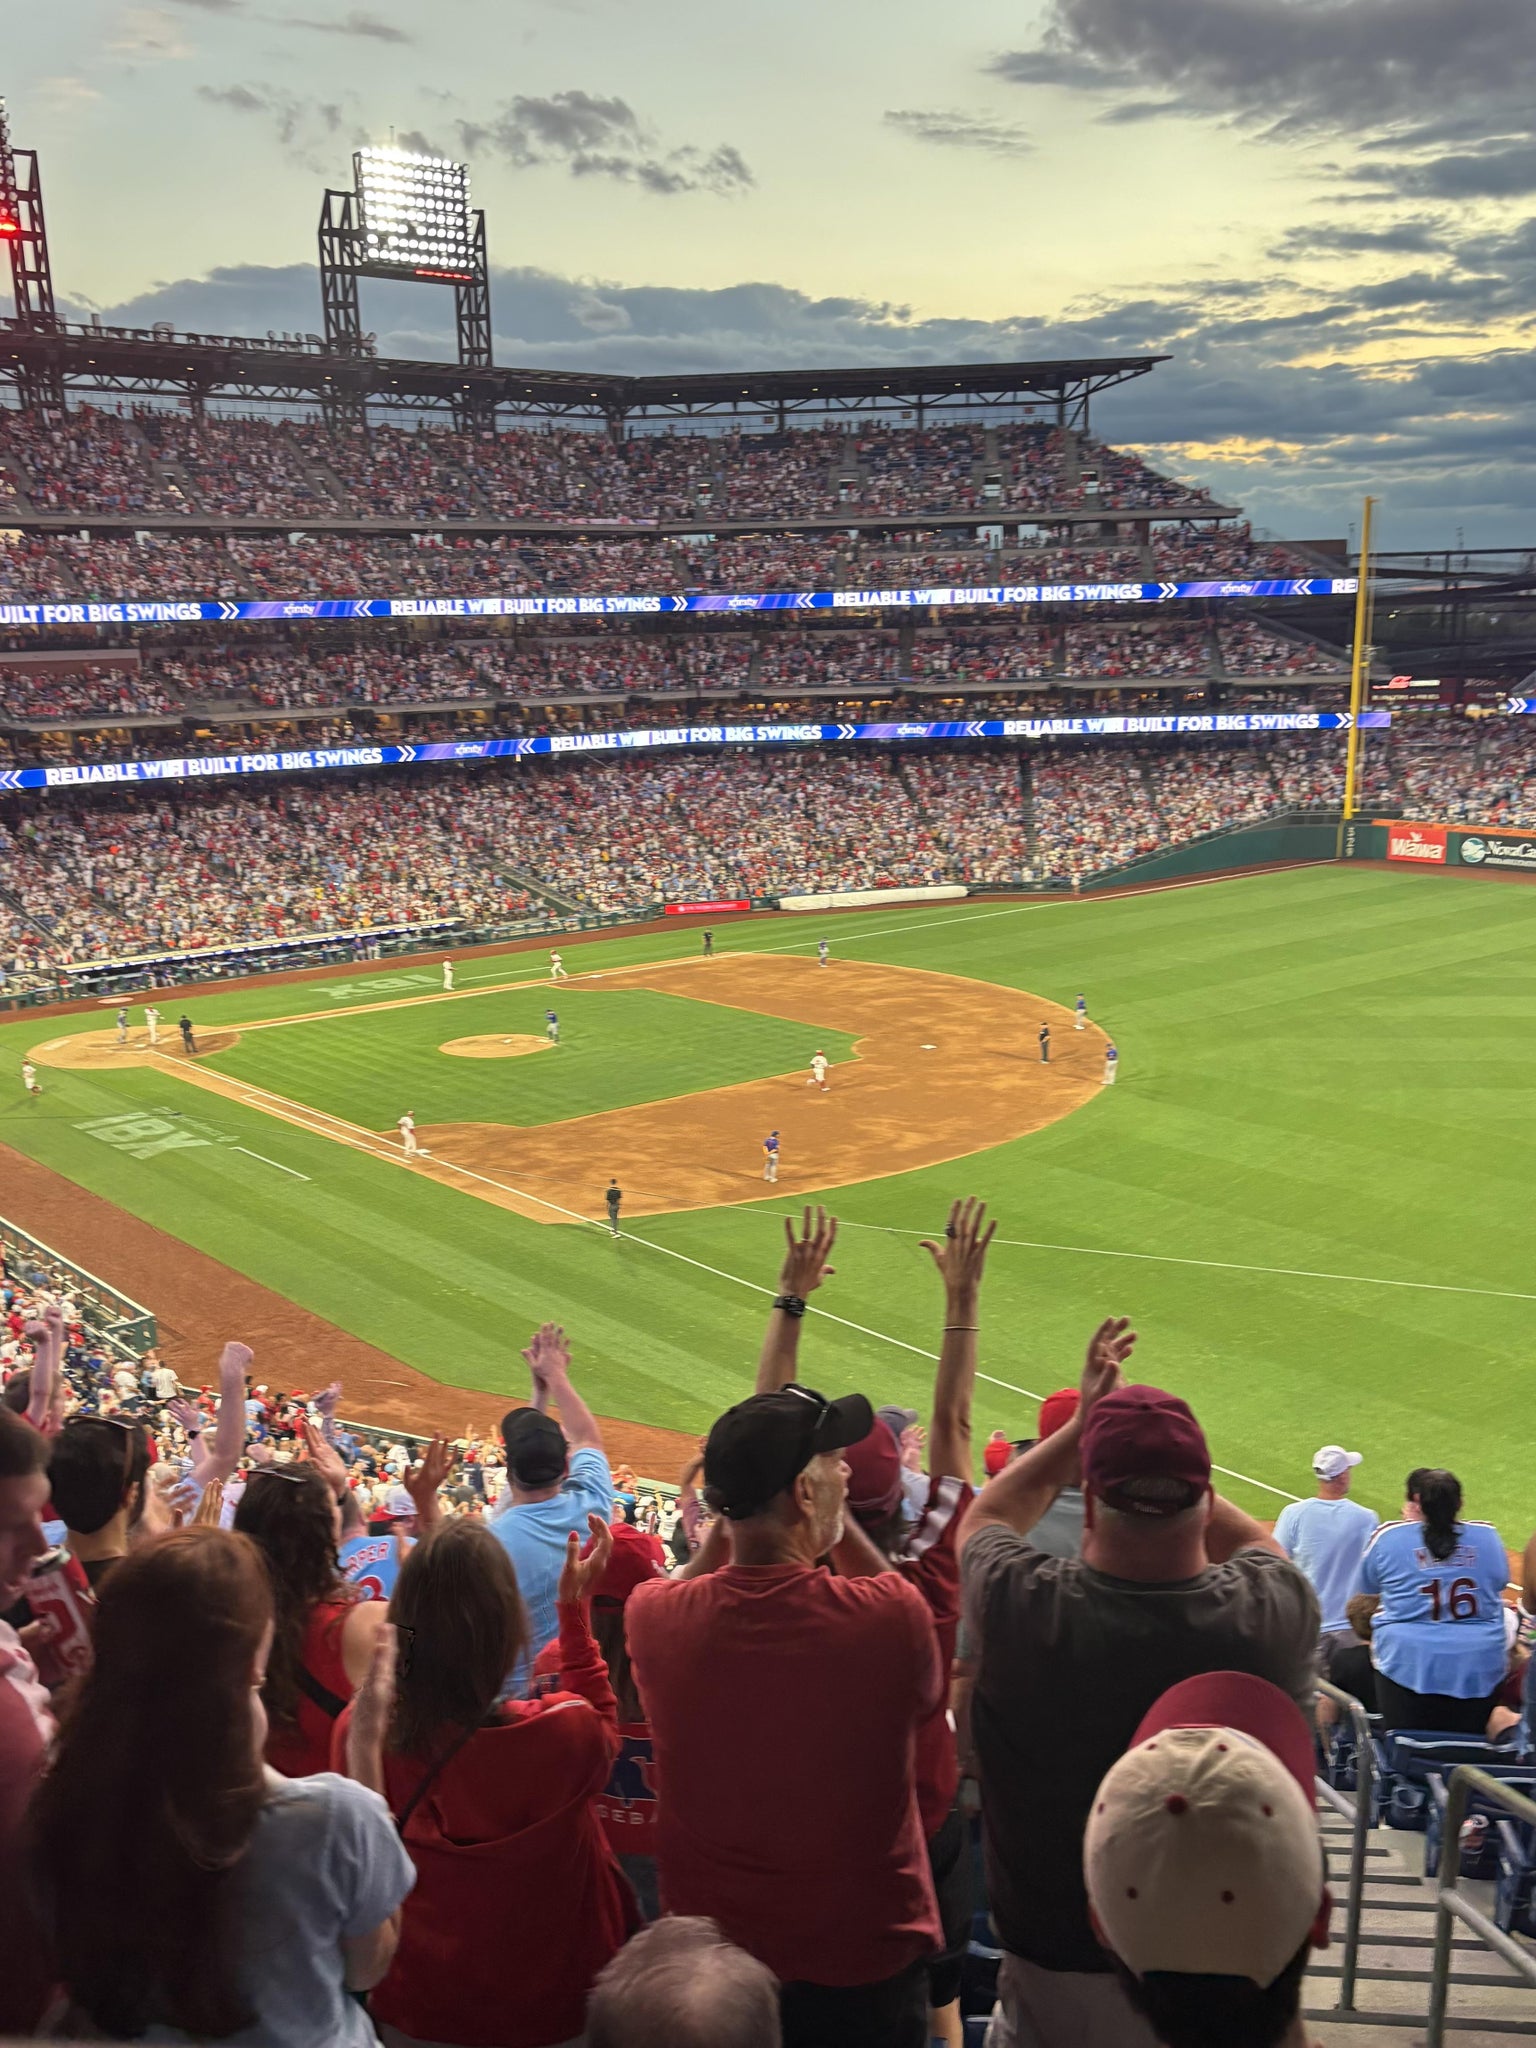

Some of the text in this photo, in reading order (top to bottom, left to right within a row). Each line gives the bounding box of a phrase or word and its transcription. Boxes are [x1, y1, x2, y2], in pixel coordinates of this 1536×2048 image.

[833, 591, 910, 606] RELIABLE
[955, 588, 1001, 603] BUILT
[1003, 587, 1039, 602] FOR
[1042, 586, 1070, 600] BIG
[1075, 584, 1143, 600] SWINGS
[1332, 579, 1357, 593] RE
[44, 605, 84, 622] FOR
[89, 604, 123, 622] BIG
[127, 603, 202, 621] SWINGS
[391, 600, 464, 615] RELIABLE
[505, 599, 545, 613] BUILT
[550, 598, 576, 613] FOR
[580, 598, 601, 612] BIG
[606, 597, 661, 611] SWINGS
[1004, 719, 1083, 735] RELIABLE
[1128, 716, 1176, 732] BUILT
[1178, 716, 1213, 731] FOR
[1217, 715, 1246, 730] BIG
[1250, 714, 1320, 729] SWINGS
[551, 733, 617, 751] RELIABLE
[653, 729, 687, 745] BUILT
[691, 728, 722, 742] FOR
[725, 727, 754, 741] BIG
[757, 725, 822, 740] SWINGS
[46, 763, 138, 786] RELIABLE
[188, 757, 238, 775] BUILT
[242, 755, 277, 772] FOR
[282, 752, 312, 769] BIG
[315, 748, 382, 766] SWINGS
[1391, 838, 1445, 858] Wawa
[1418, 1577, 1478, 1622] 16
